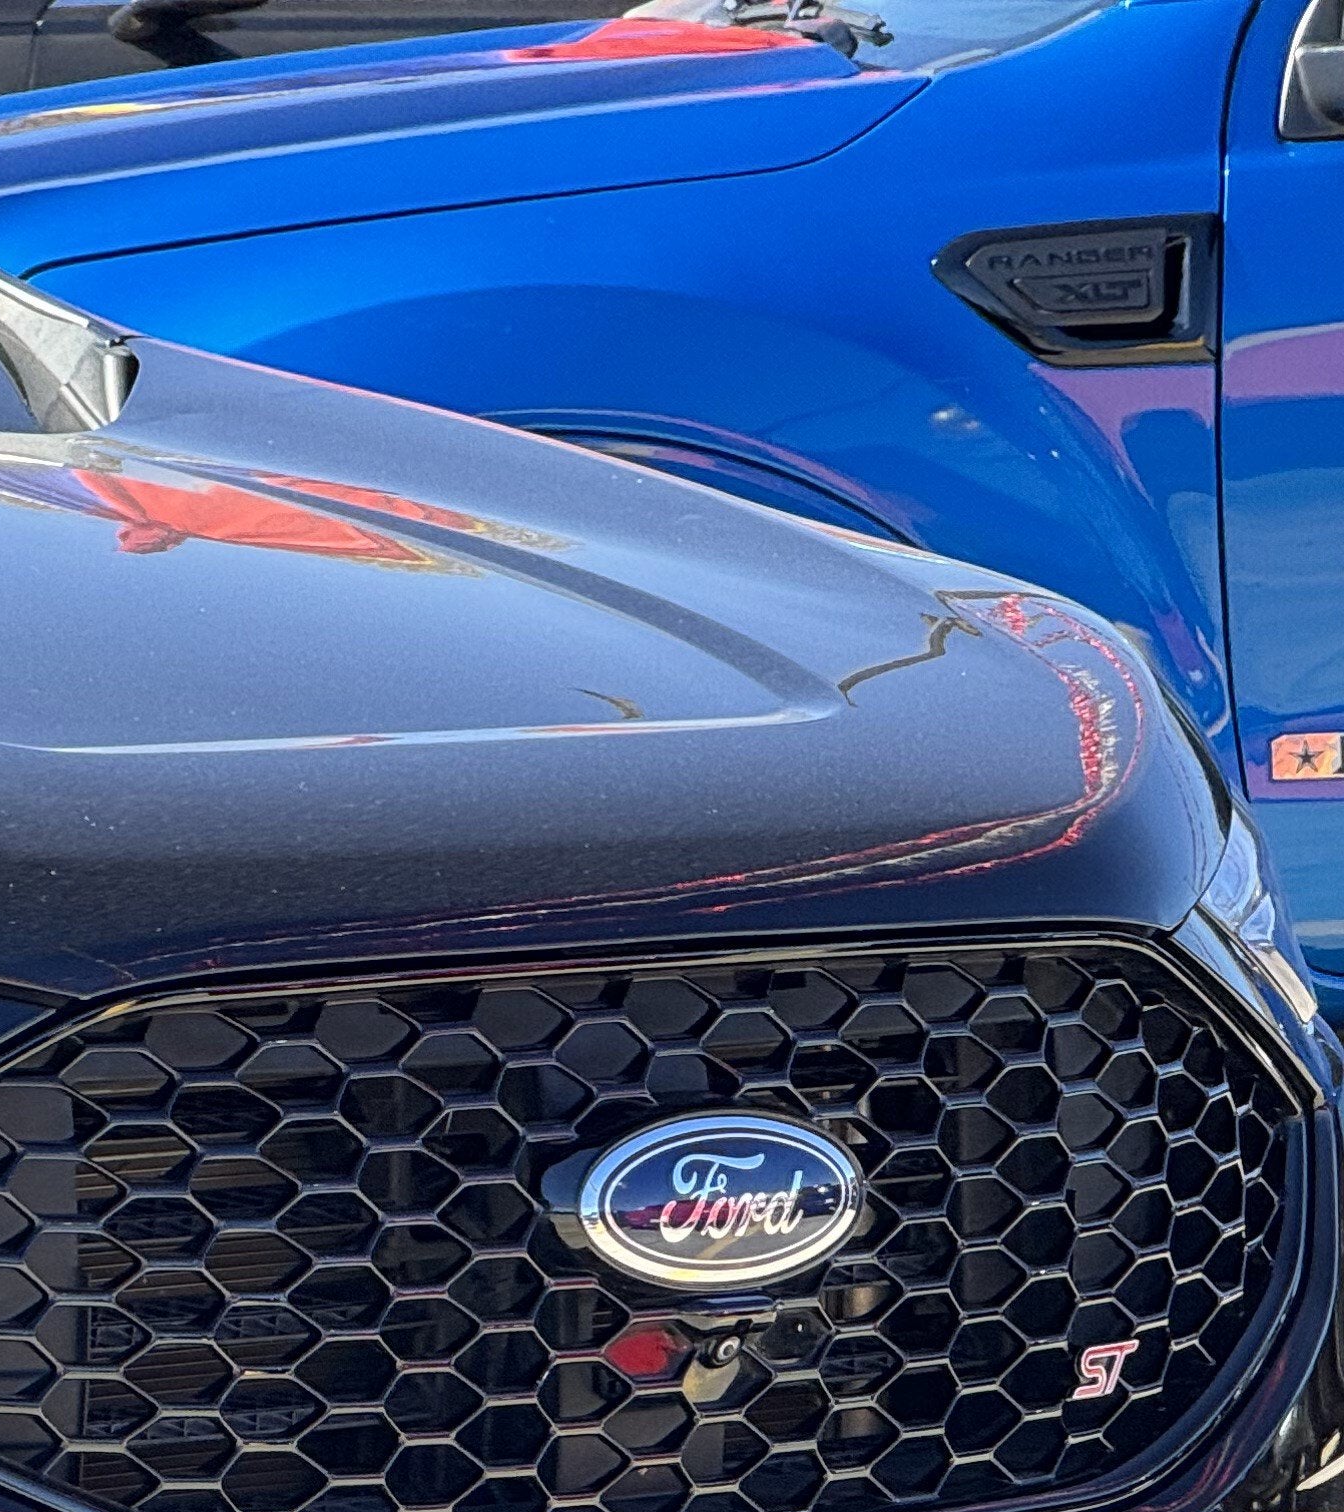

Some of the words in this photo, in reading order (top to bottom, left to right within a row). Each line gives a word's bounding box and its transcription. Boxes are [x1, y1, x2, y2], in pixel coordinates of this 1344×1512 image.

[986, 246, 1154, 270] RANGER
[1054, 278, 1142, 301] XLT
[659, 1152, 804, 1243] Ford
[1072, 1339, 1140, 1400] ST
